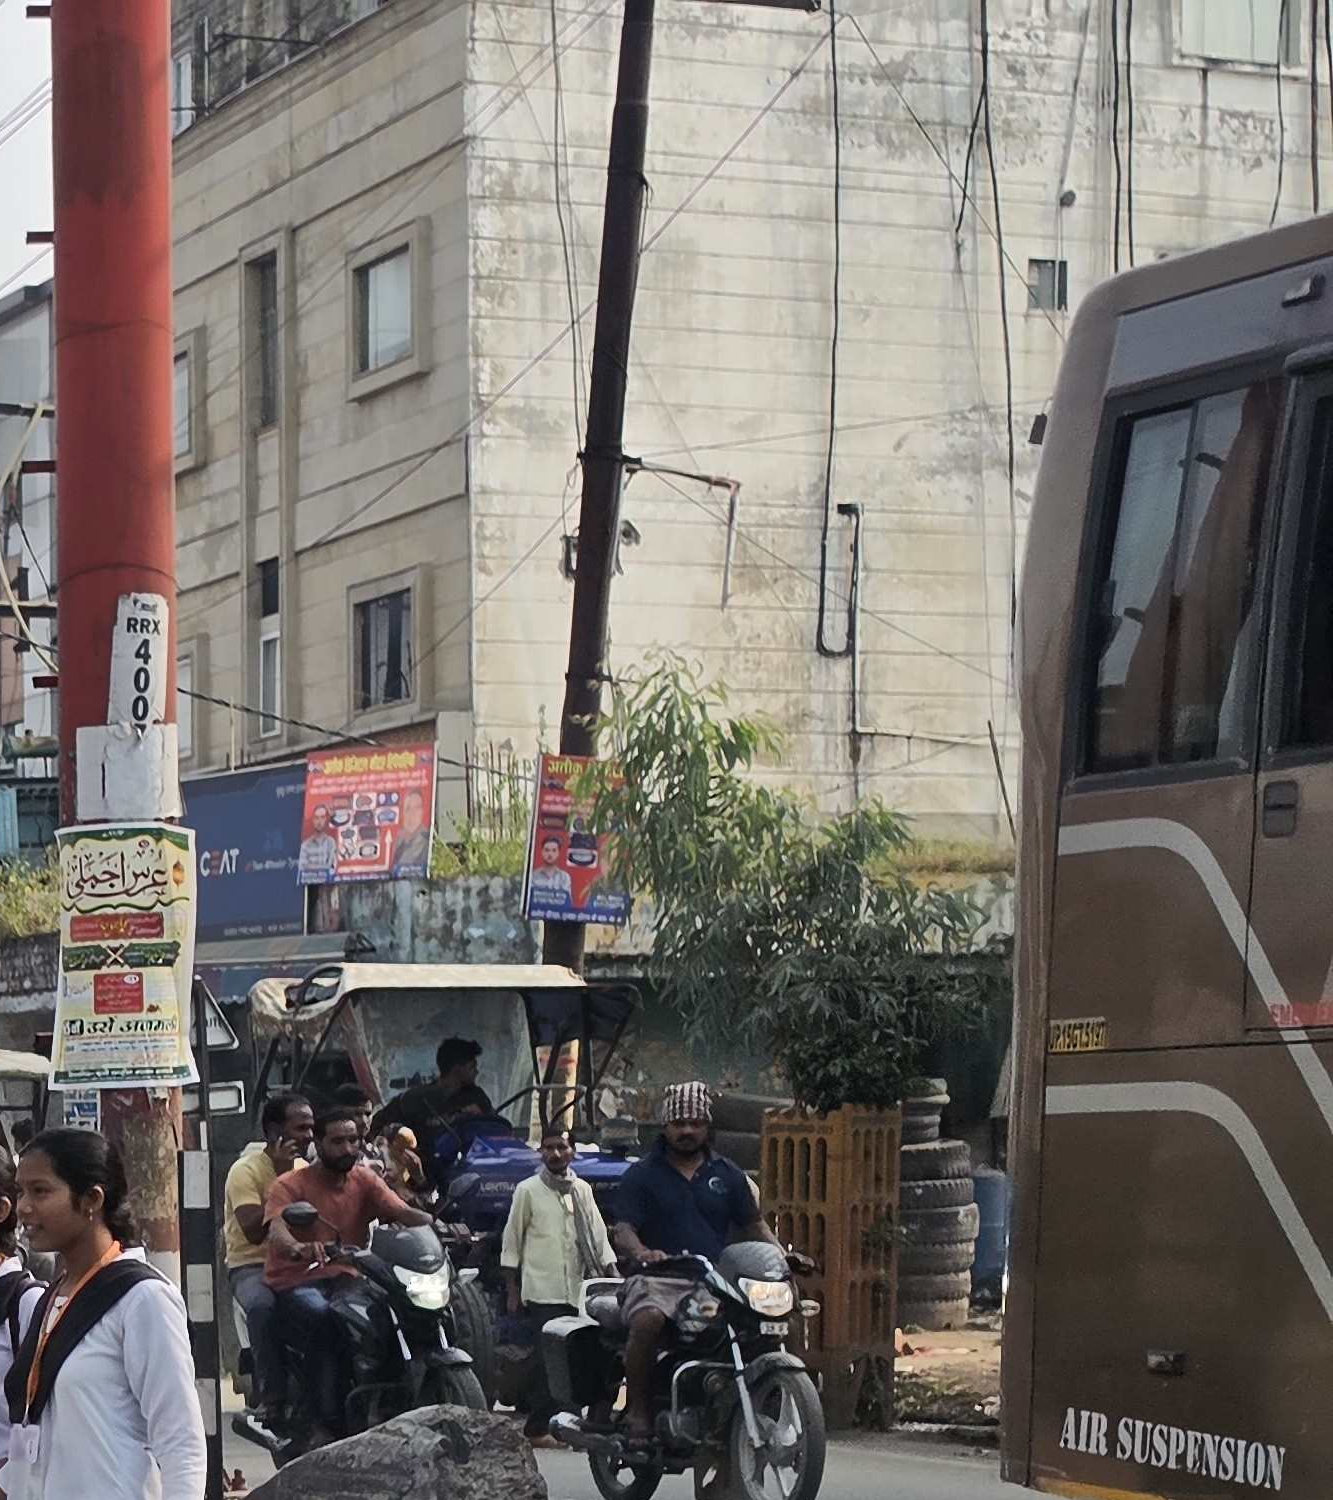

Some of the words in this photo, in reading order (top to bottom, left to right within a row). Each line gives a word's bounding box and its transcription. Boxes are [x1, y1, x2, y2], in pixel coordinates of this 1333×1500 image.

[126, 616, 161, 635] RRX
[200, 848, 240, 877] CEAT
[1059, 1407, 1109, 1457] AIR
[1116, 1416, 1286, 1491] SUSPENSION
